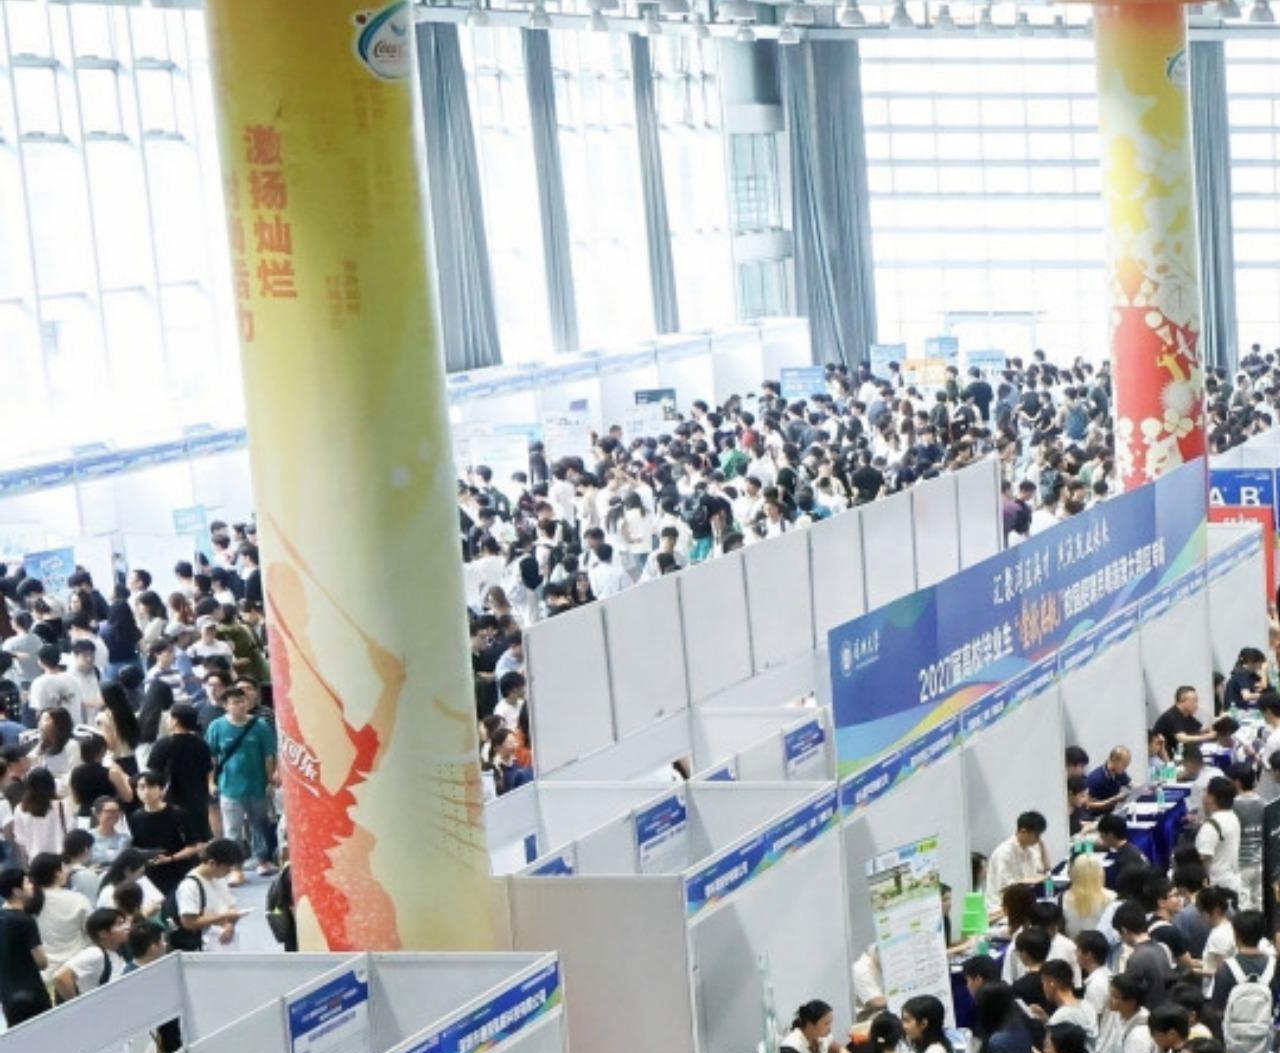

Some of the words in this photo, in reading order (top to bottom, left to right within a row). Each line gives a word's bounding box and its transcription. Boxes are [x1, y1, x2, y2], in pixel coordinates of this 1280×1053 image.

[243, 124, 298, 299] 激扬灿烂
[1240, 486, 1261, 506] B
